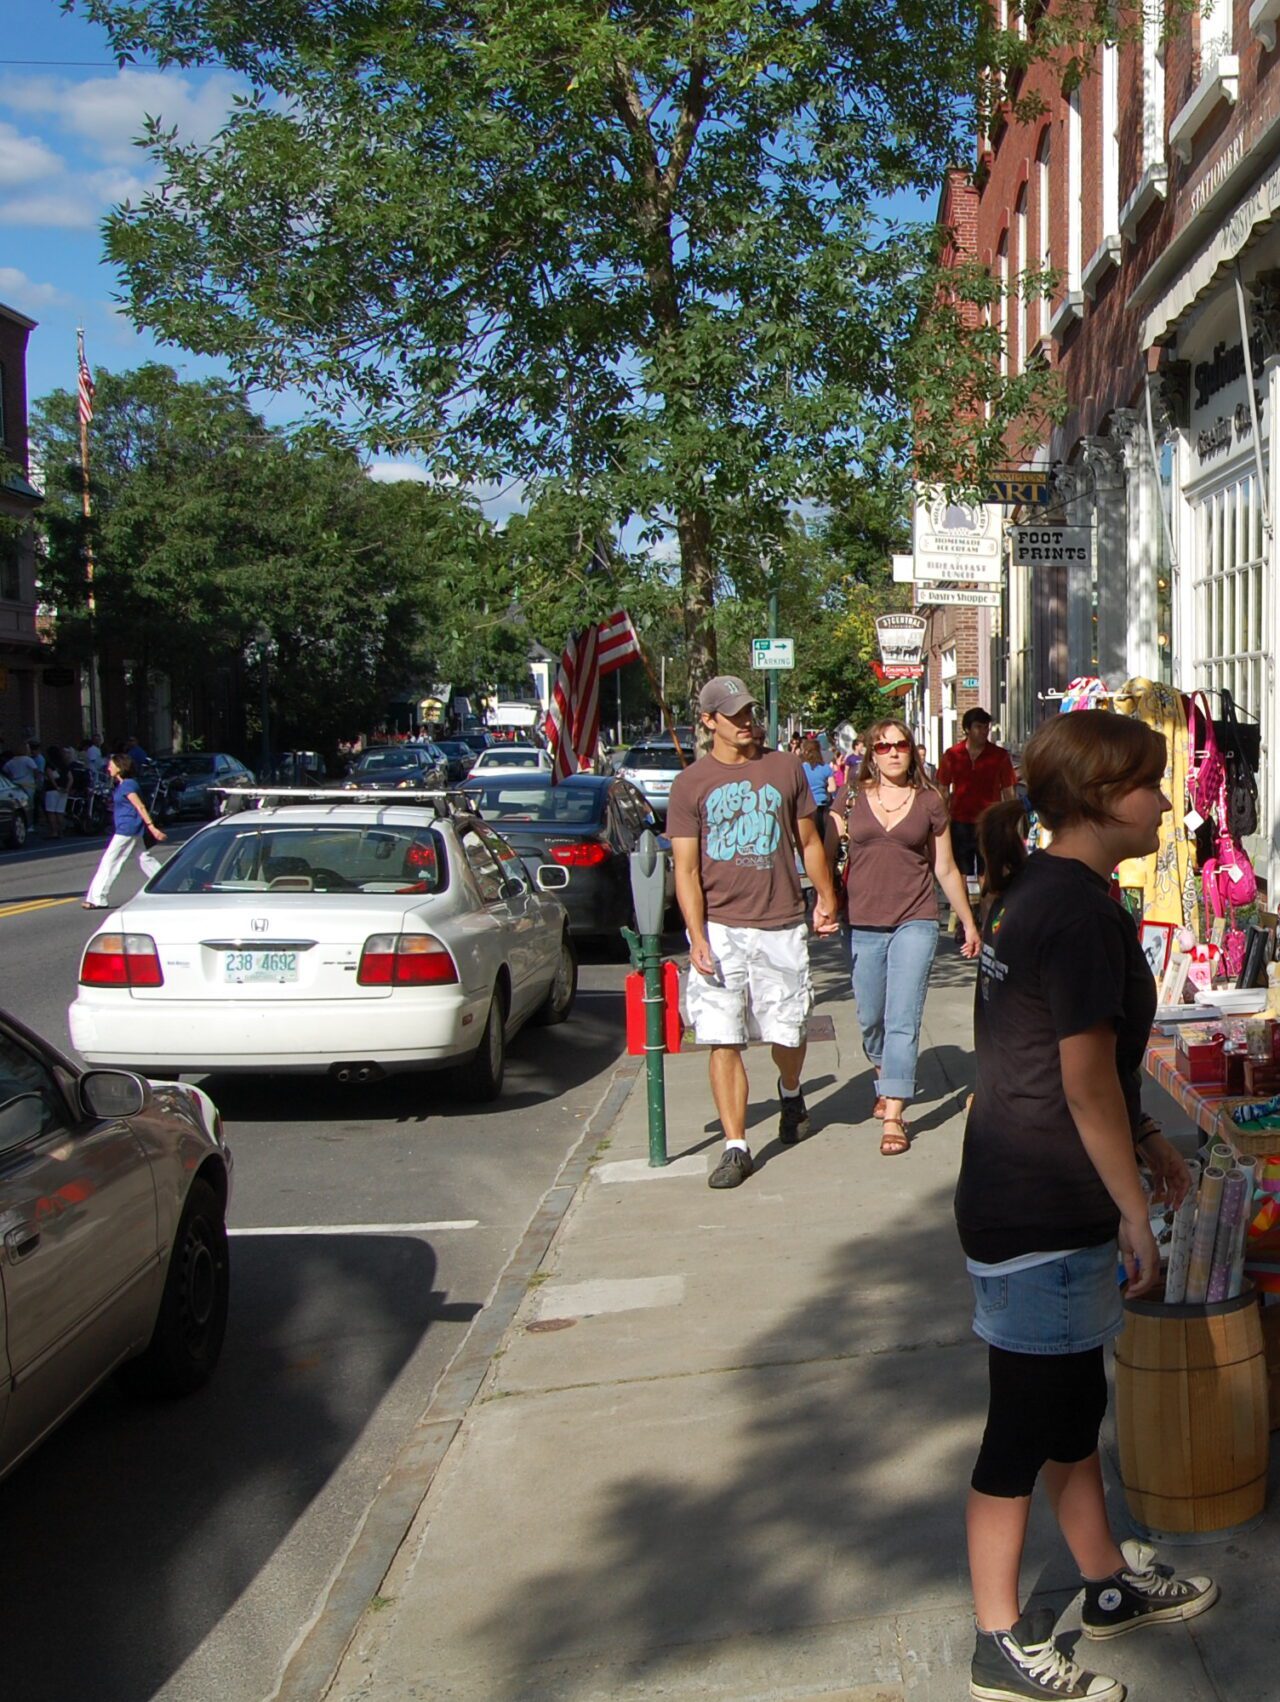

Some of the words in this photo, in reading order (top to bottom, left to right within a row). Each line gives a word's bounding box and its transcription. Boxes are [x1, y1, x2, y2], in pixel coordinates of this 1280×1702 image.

[1190, 131, 1245, 216] STATIONERY
[984, 482, 1047, 502] ART
[935, 537, 980, 546] HOMEMADE
[1018, 532, 1063, 545] FOOT
[951, 545, 978, 553] CREAM
[1018, 548, 1087, 560] PRINTS
[927, 561, 986, 572] BREAKFAST
[942, 570, 975, 579] LUNCH
[929, 592, 955, 601] Pastry
[957, 593, 987, 603] Shoppe
[891, 616, 920, 627] CENTRAL
[758, 652, 790, 665] PARKING
[705, 780, 757, 824] PASS
[758, 783, 782, 813] IT
[226, 953, 253, 971] 238
[261, 953, 296, 971] 4692
